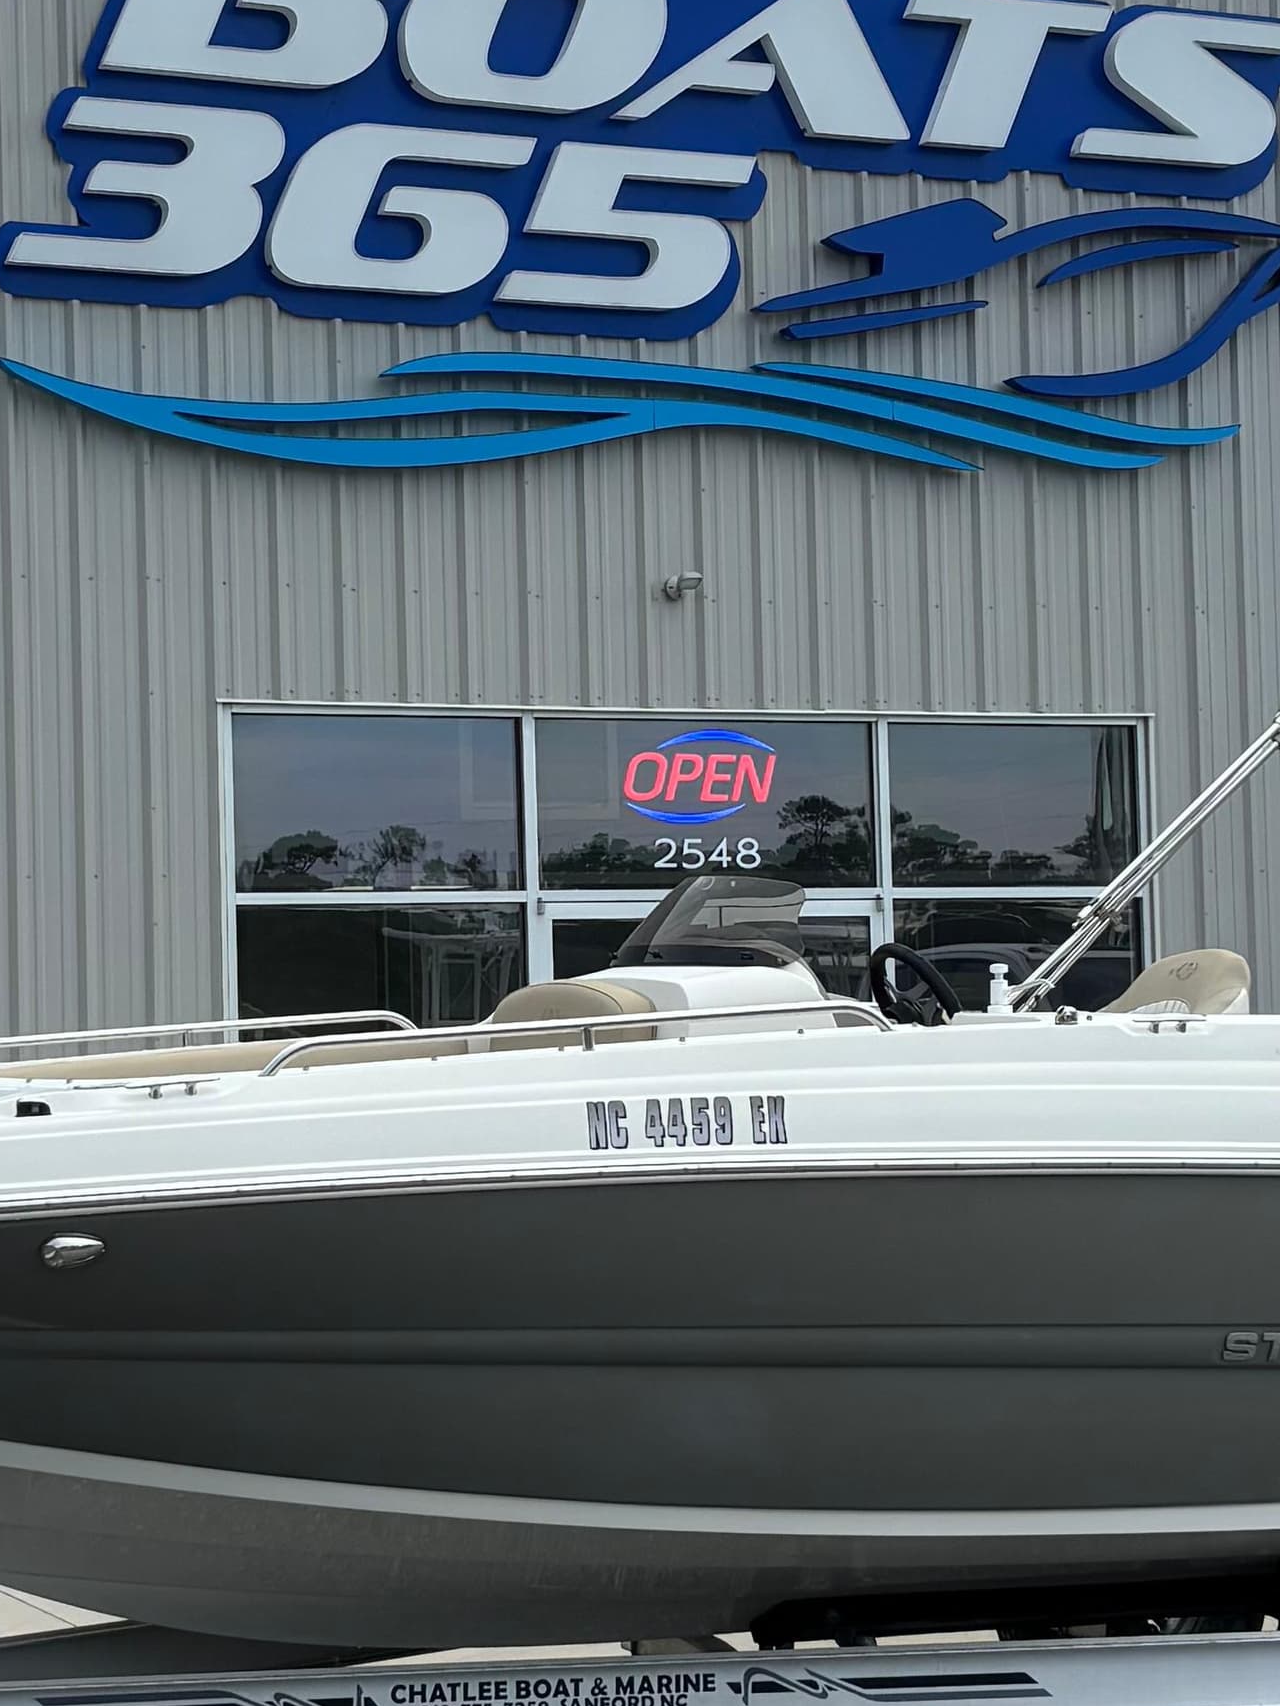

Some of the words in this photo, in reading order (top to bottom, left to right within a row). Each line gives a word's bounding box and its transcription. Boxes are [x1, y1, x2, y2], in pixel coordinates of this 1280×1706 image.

[3, 94, 759, 316] 365
[623, 751, 777, 803] OPEN
[653, 837, 762, 870] 2548
[586, 1100, 629, 1150] NC
[644, 1096, 734, 1148] 4459
[749, 1095, 788, 1145] EK
[390, 1680, 508, 1705] CHATLEE
[515, 1677, 584, 1699] BOAT
[591, 1677, 608, 1697] &
[615, 1673, 716, 1695] MARINE
